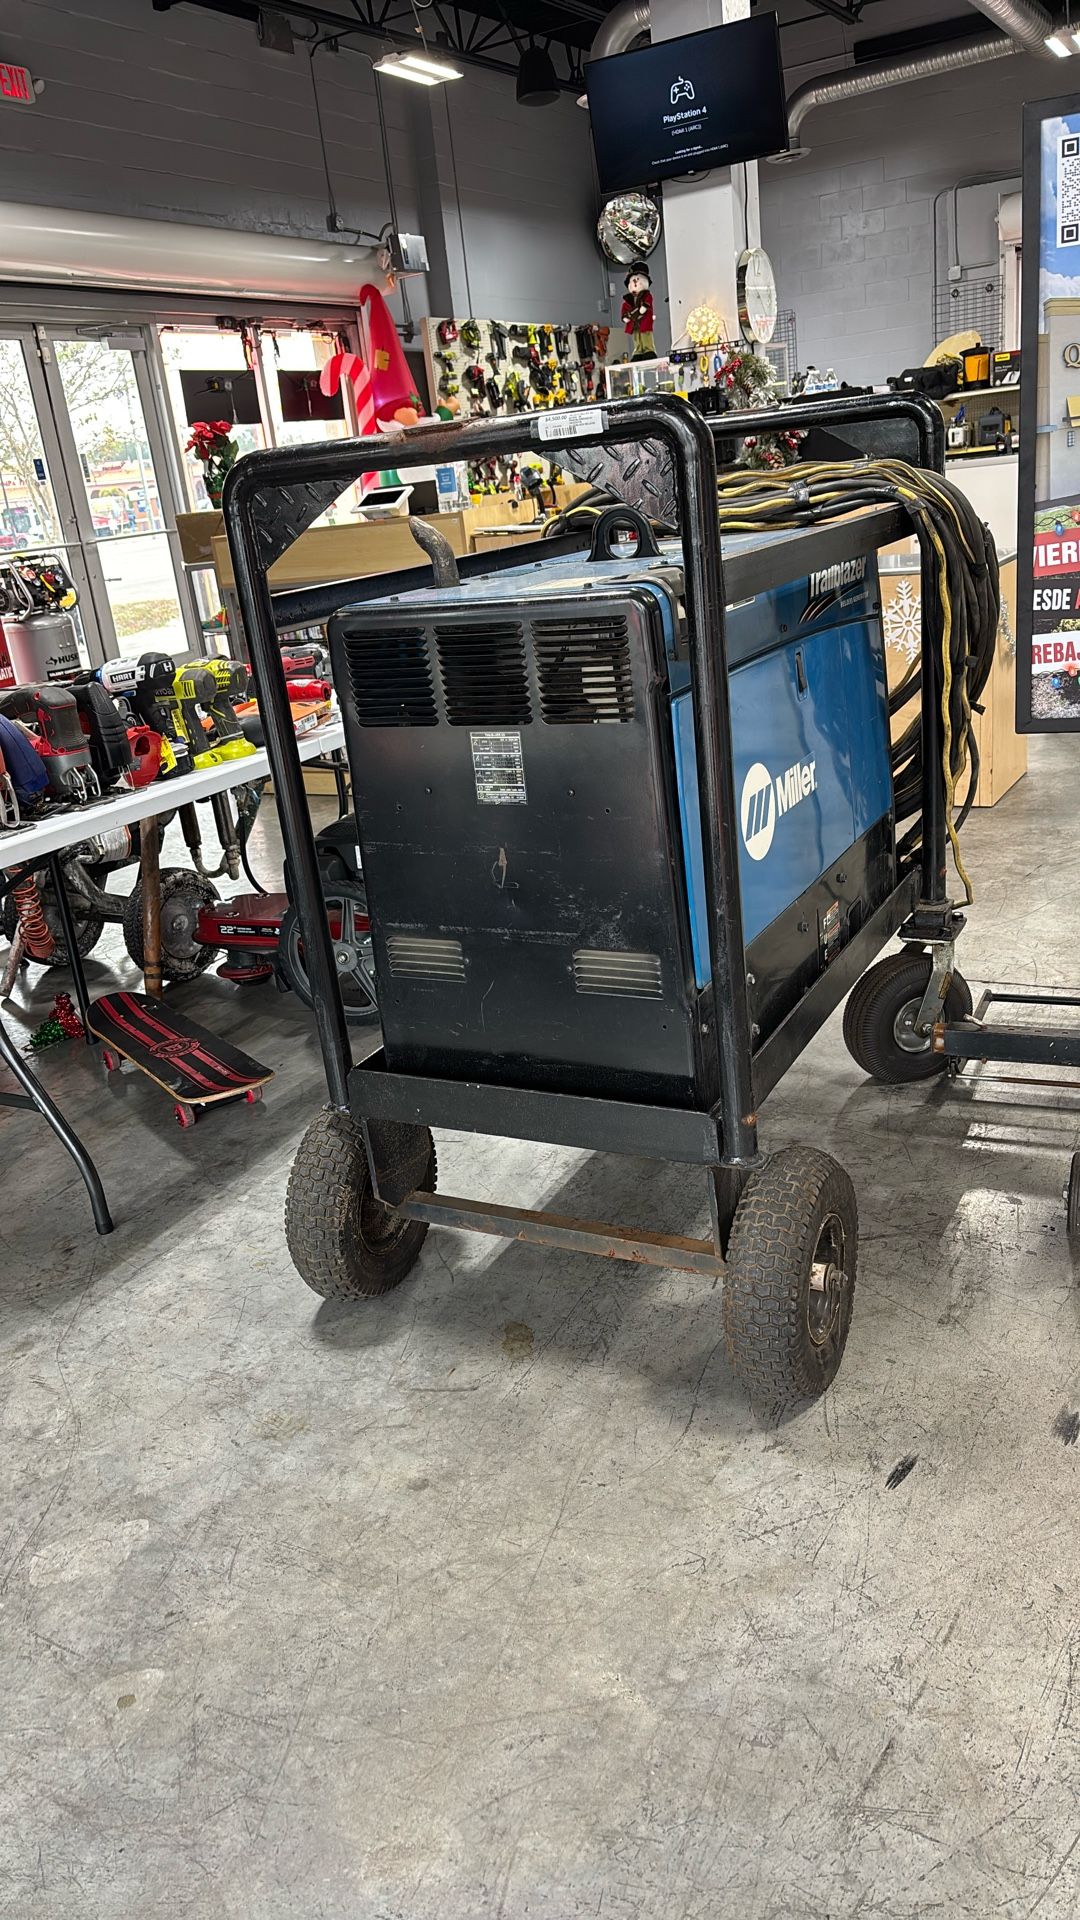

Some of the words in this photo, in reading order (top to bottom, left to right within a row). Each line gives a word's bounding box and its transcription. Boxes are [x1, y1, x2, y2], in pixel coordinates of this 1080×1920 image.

[0, 64, 31, 101] EXIT
[663, 109, 701, 123] PlayStation
[545, 414, 568, 423] $4,500.00
[1033, 540, 1080, 568] IER
[810, 556, 867, 598] Trailblazer
[112, 672, 133, 682] HART
[776, 760, 816, 817] Miller
